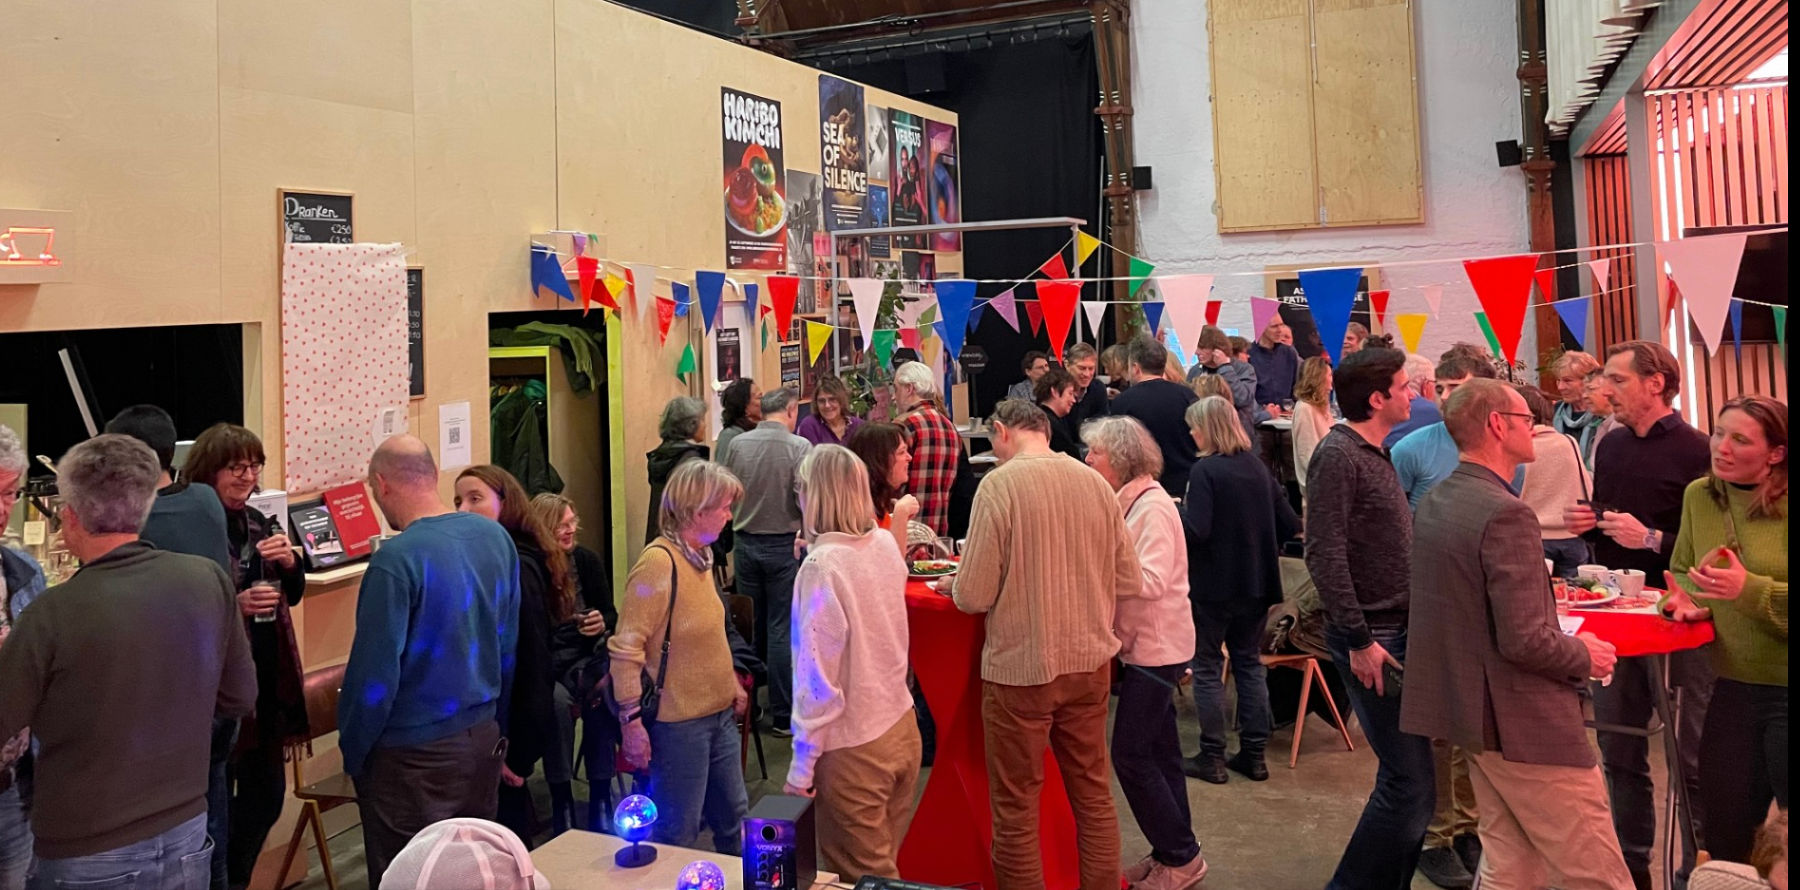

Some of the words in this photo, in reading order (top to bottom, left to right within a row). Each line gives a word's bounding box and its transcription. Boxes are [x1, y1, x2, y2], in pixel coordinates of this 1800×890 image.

[723, 93, 778, 127] HARIBO
[724, 116, 780, 149] KIMCHI
[823, 121, 846, 146] SEA
[895, 127, 922, 148] VERSUS
[823, 145, 840, 165] OF
[824, 169, 867, 192] SILENCE
[756, 844, 783, 852] VONYX
